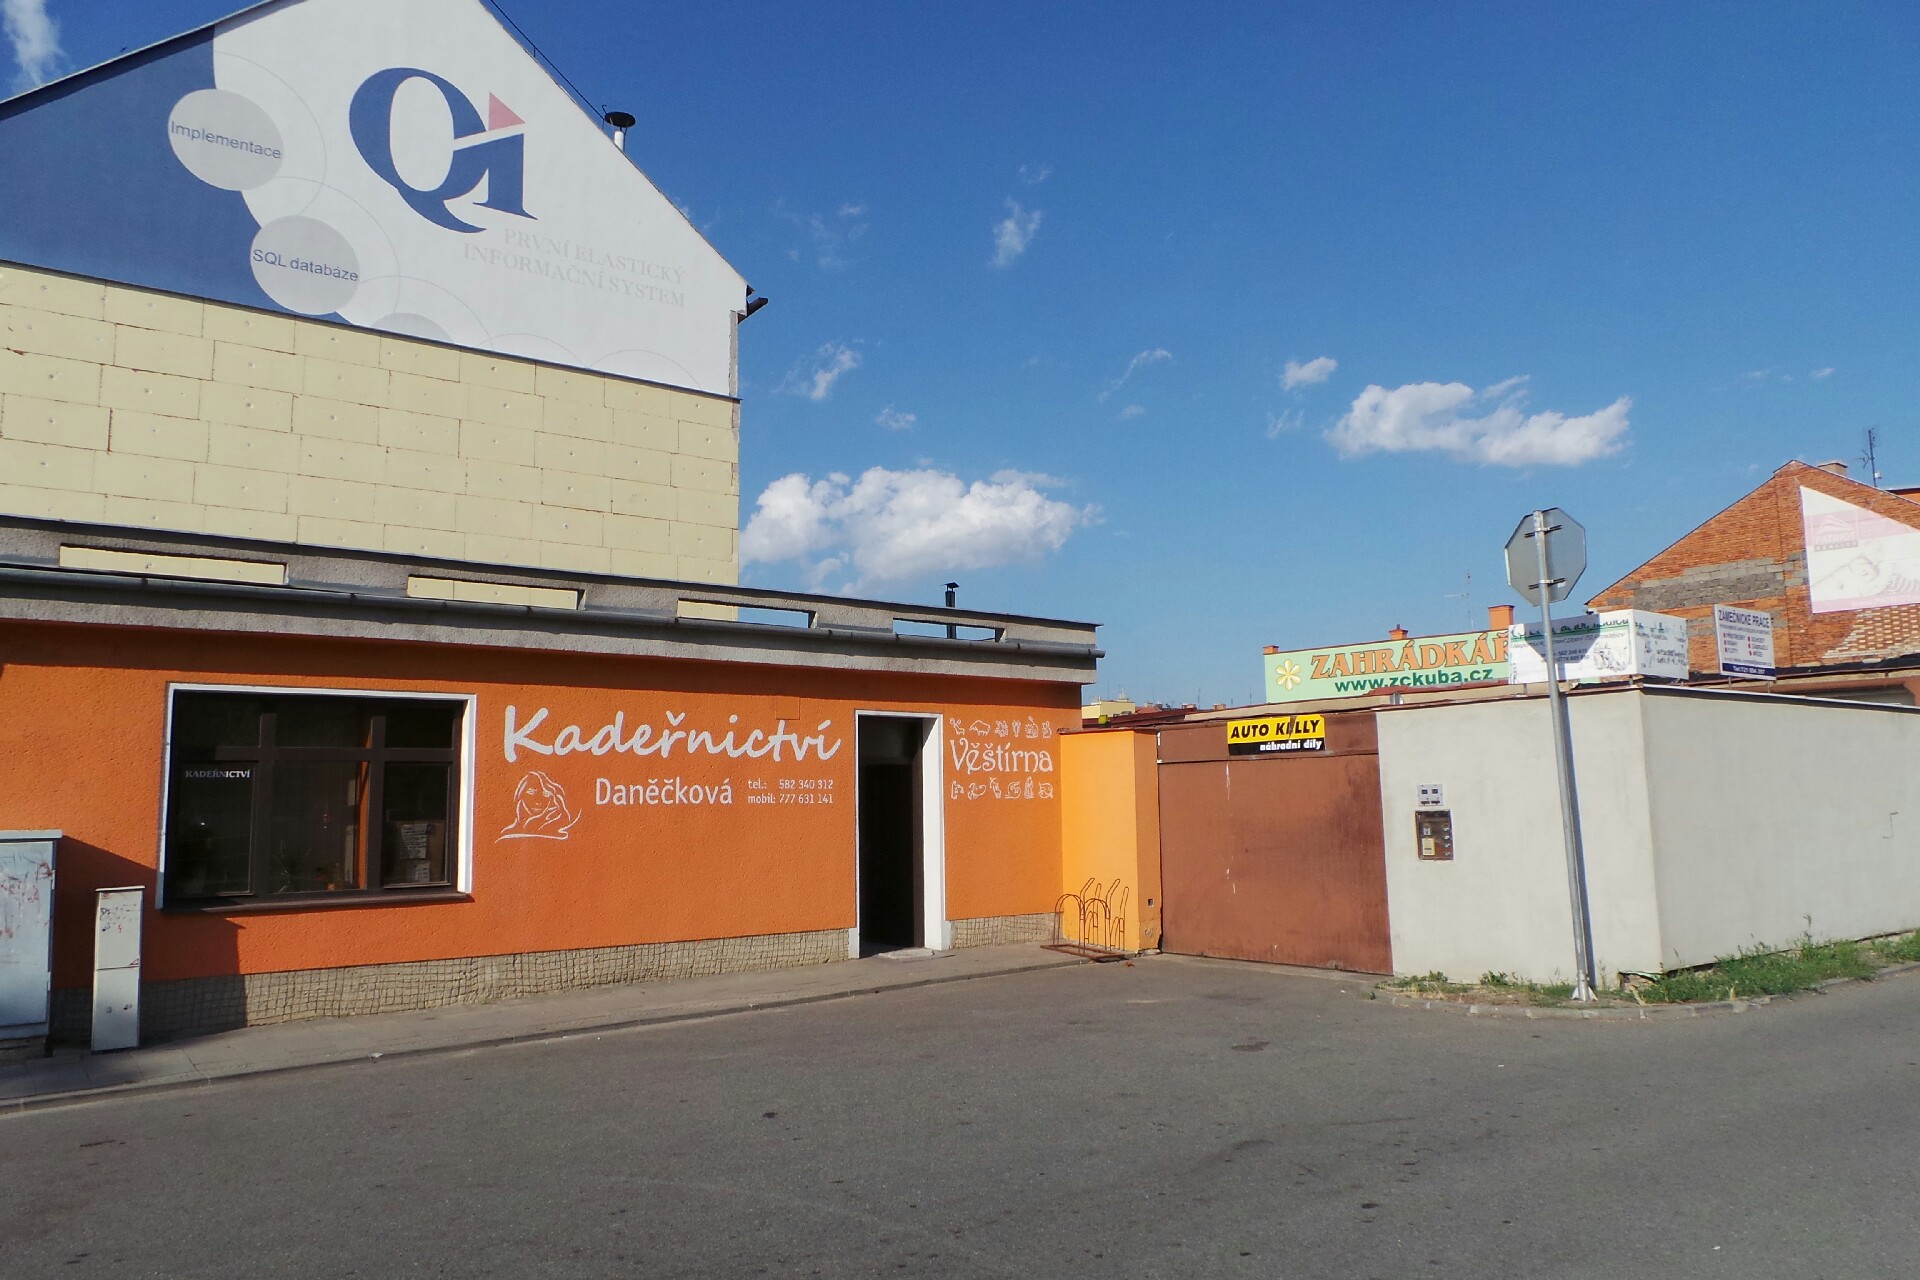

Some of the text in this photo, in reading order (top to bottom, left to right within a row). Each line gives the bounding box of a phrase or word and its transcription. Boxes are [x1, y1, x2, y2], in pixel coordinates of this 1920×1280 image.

[171, 121, 281, 159] Implementace
[252, 249, 359, 282] SQL databáze
[463, 243, 604, 289] INFORMAČNÍ
[504, 228, 686, 285] PRVNÍ ELASTICKÝ
[1335, 668, 1493, 692] www.zckuba.cz
[503, 704, 842, 763] Kadeřnictví
[1230, 724, 1269, 739] AUTO
[950, 737, 1054, 775] Věštírna
[595, 776, 734, 805] Daněčková
[747, 778, 834, 790] tel.: 582 340 312
[747, 793, 834, 804] mobil: 777 631 141
